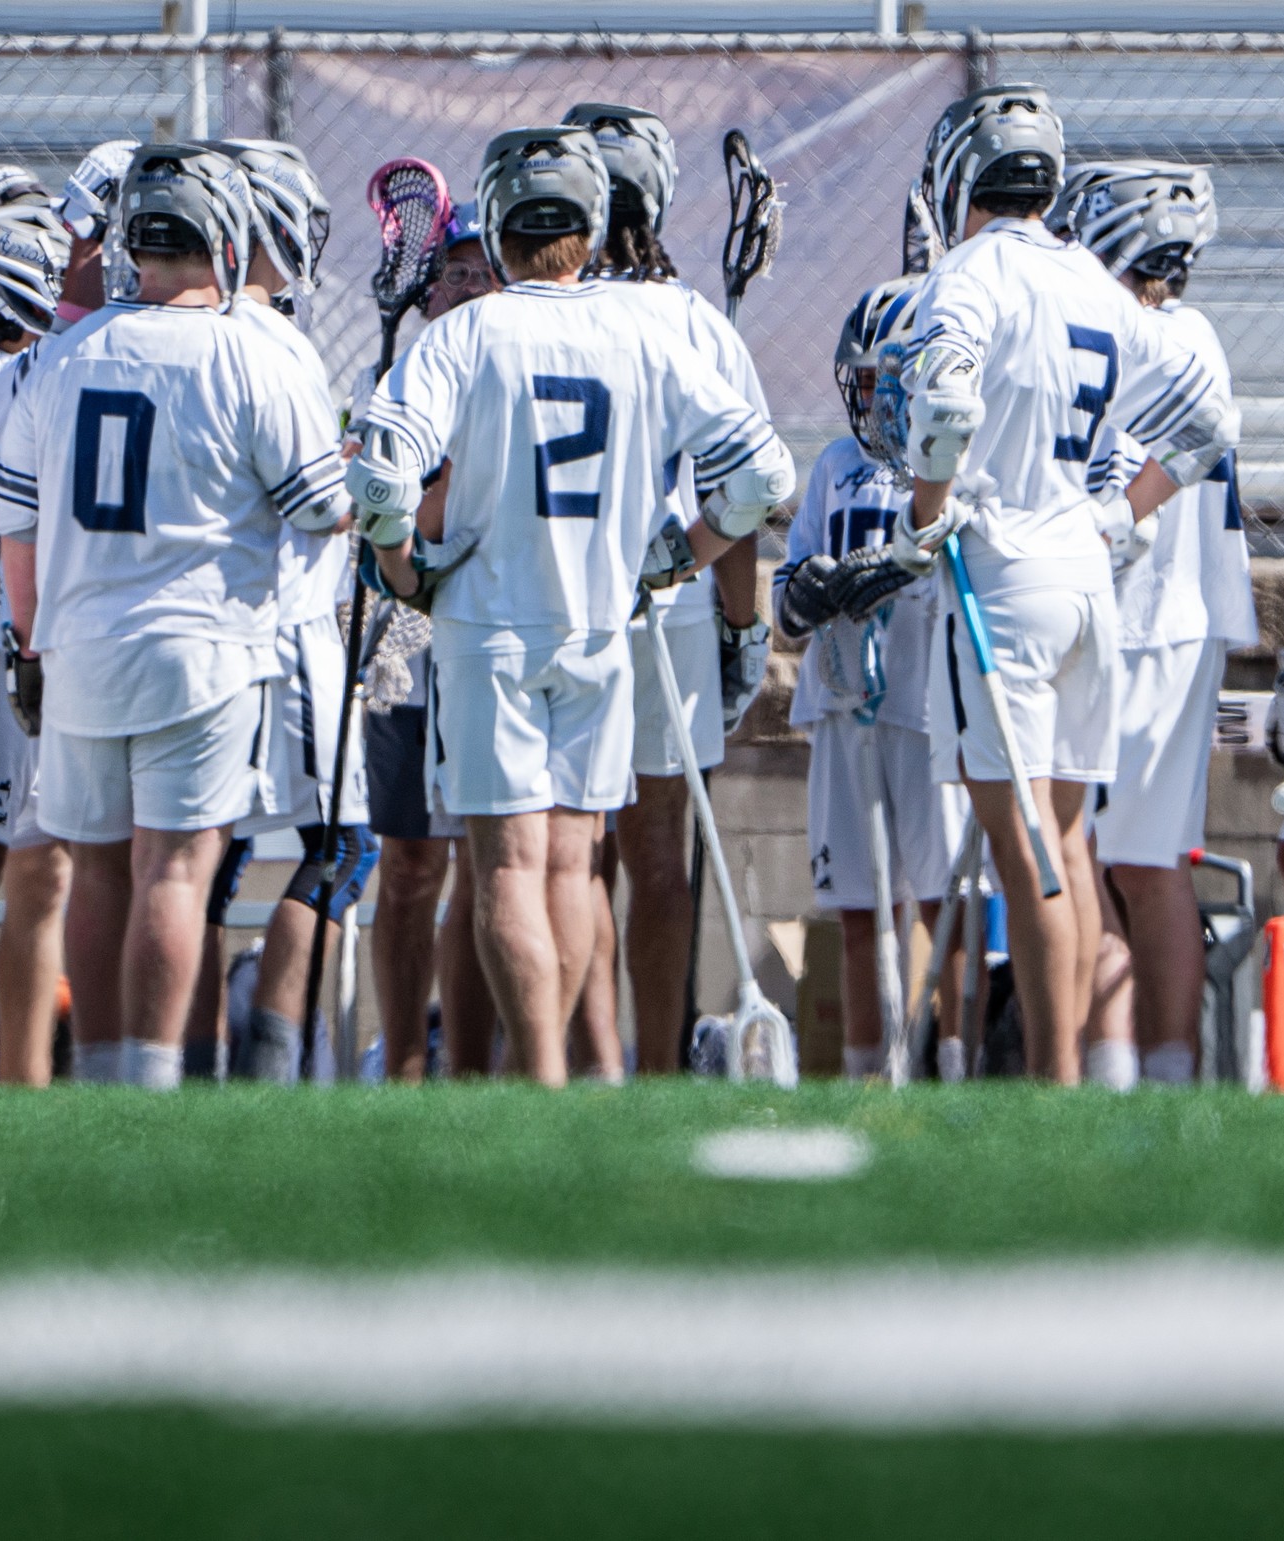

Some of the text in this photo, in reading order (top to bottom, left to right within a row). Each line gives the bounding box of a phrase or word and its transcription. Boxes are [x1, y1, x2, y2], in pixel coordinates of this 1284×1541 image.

[72, 387, 157, 535] 0
[532, 375, 612, 520] 2
[1053, 323, 1120, 462] 3
